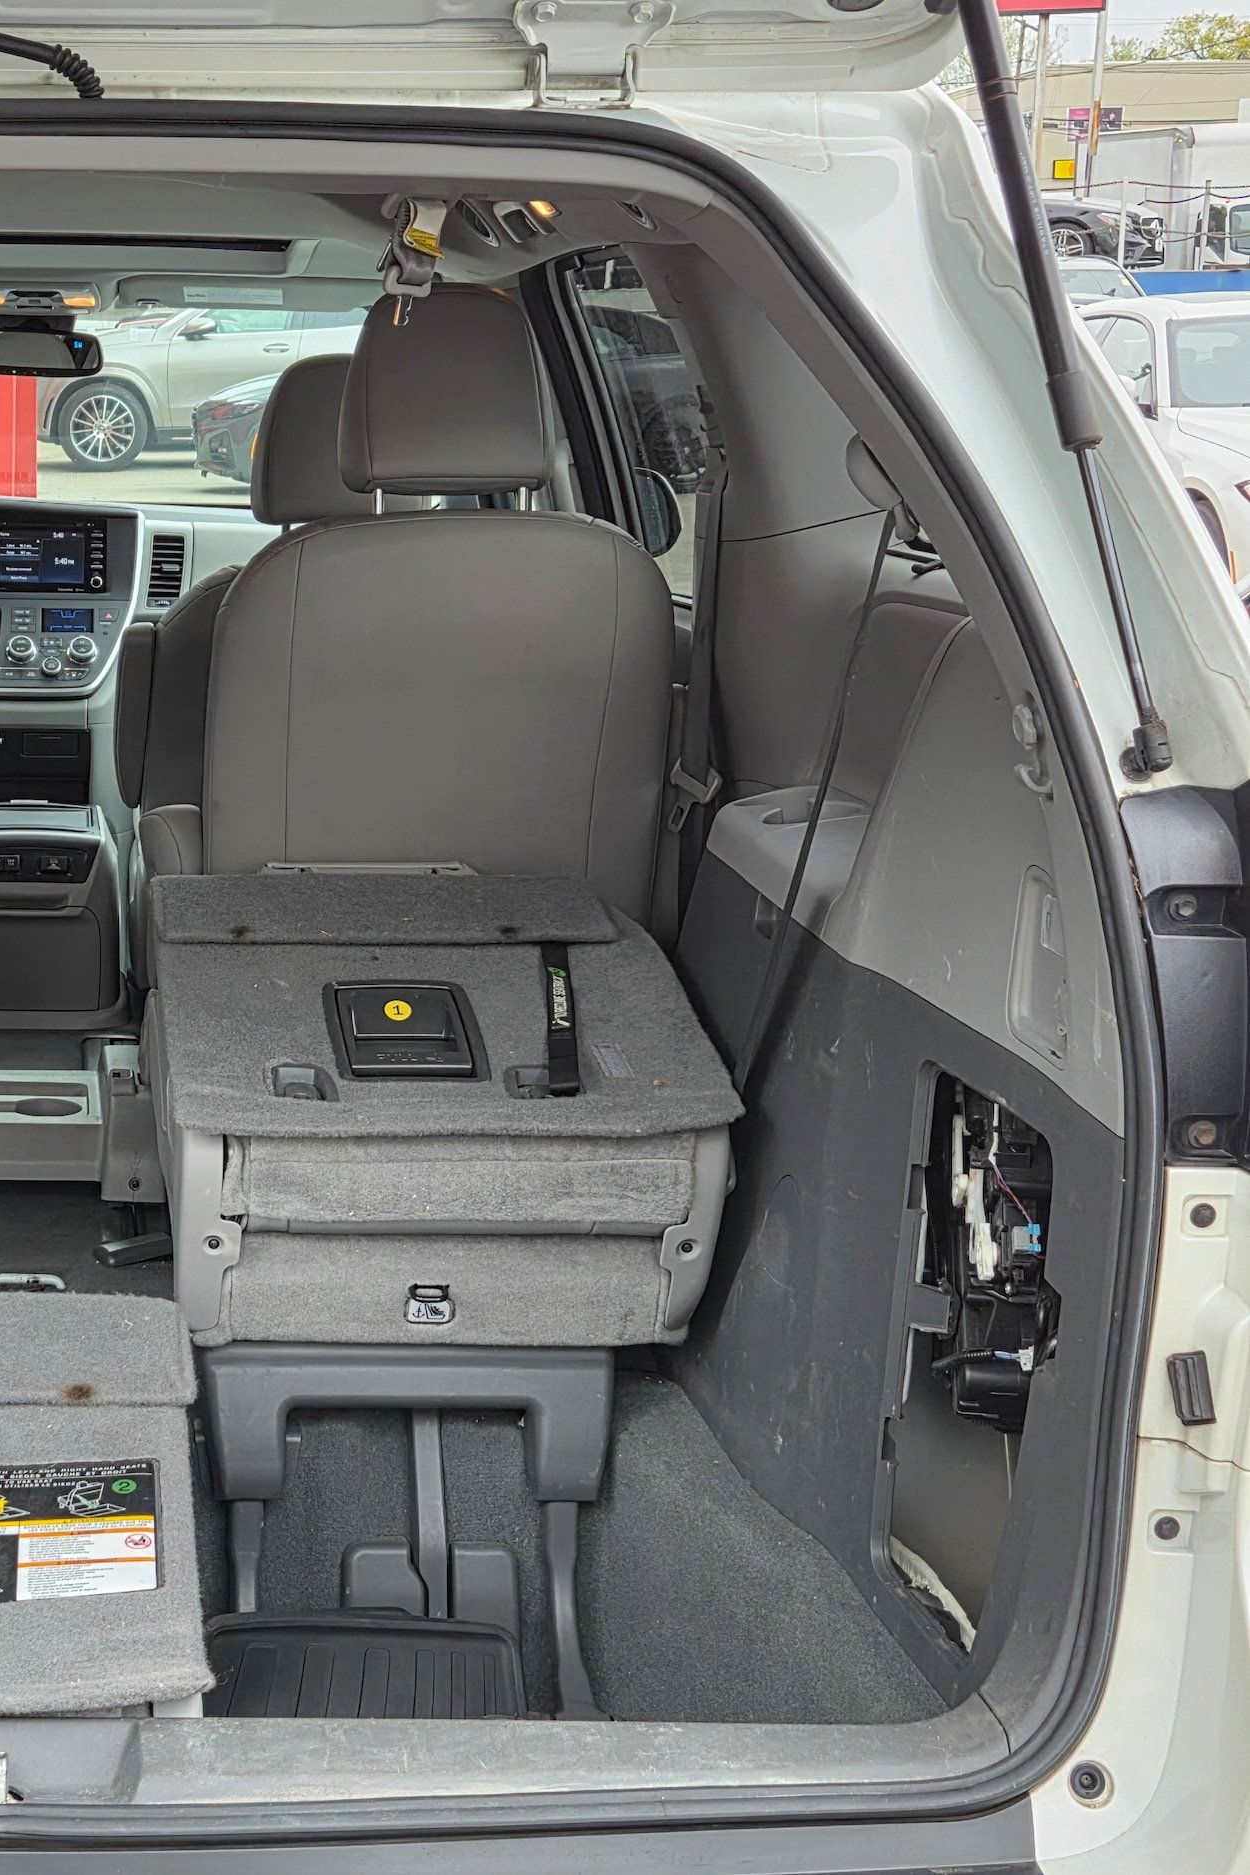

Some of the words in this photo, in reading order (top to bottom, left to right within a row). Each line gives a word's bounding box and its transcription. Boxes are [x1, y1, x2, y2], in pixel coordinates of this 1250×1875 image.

[52, 531, 65, 539] 5:40
[54, 557, 67, 565] 5:40
[392, 1005, 403, 1016] 1
[118, 1481, 130, 1491] 2
